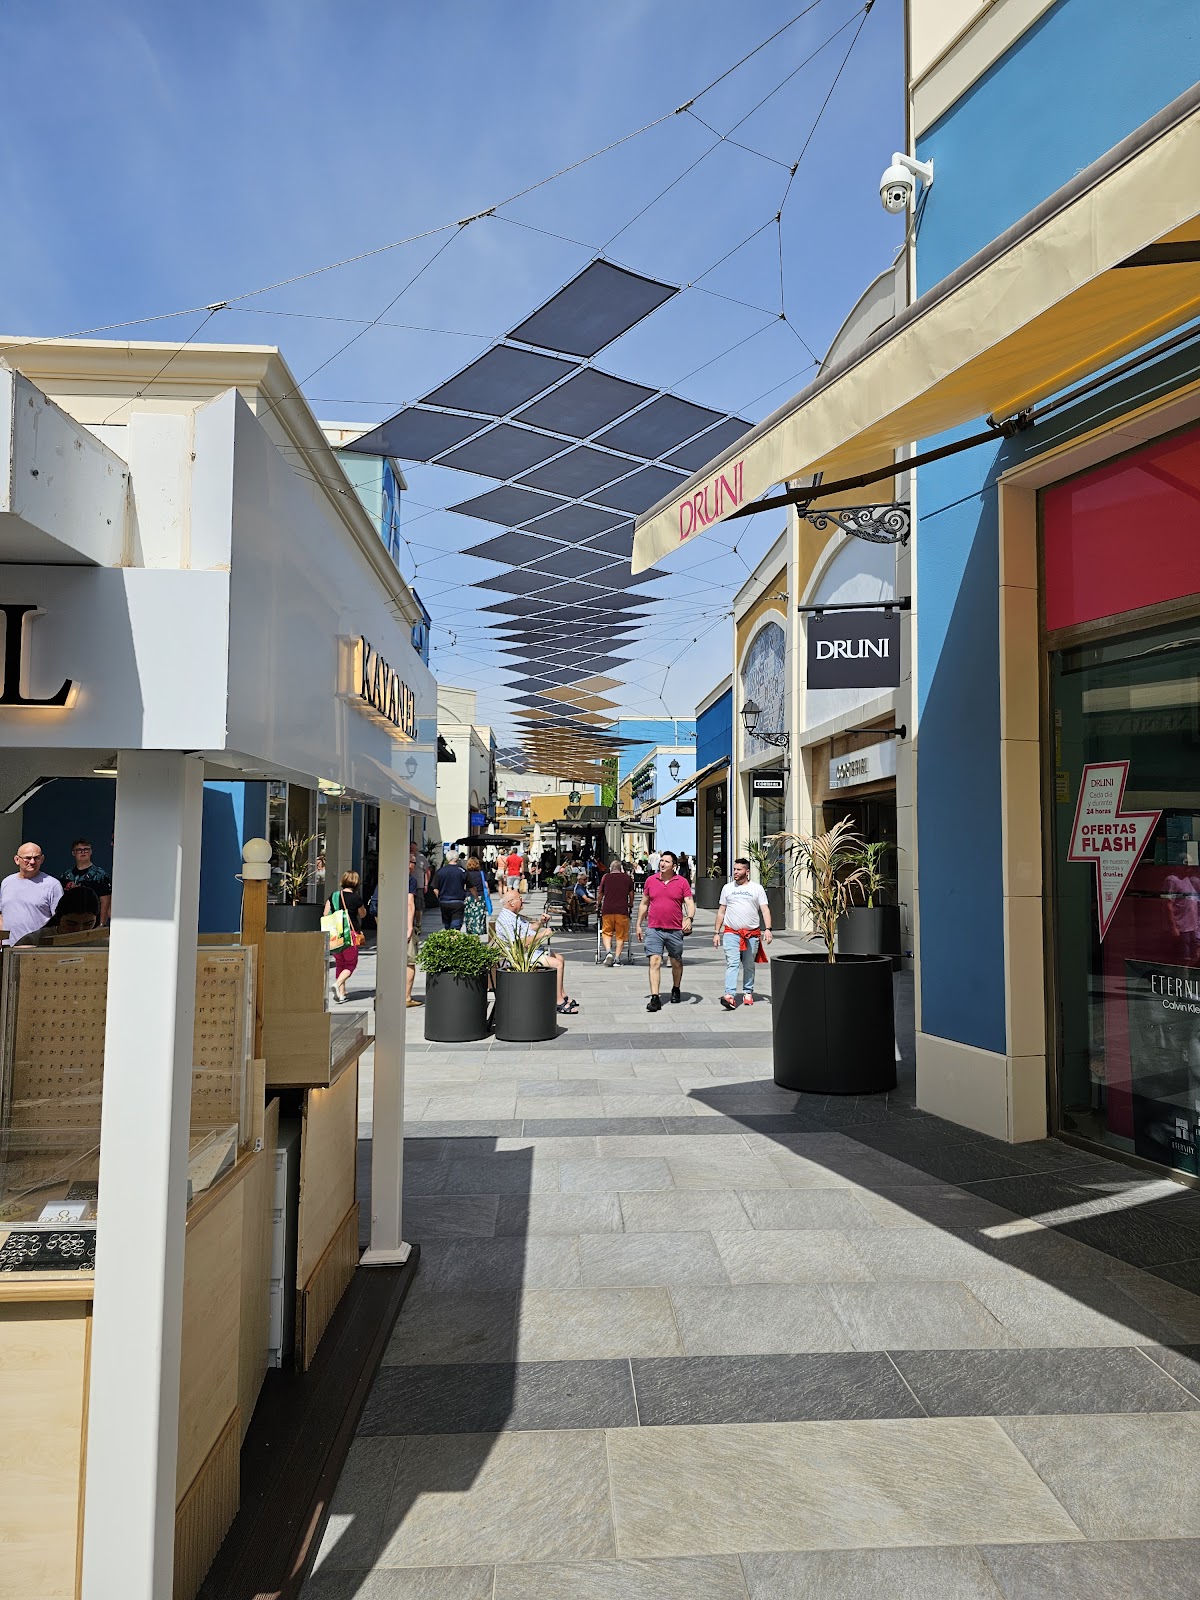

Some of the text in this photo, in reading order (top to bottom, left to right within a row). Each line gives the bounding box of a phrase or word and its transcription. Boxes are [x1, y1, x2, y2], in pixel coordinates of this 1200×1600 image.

[678, 460, 745, 542] DRUNI
[815, 638, 890, 661] DRUNI
[1091, 778, 1114, 788] DRUNI
[1081, 823, 1137, 836] OFERTAS
[1081, 837, 1136, 852] FLASH
[1162, 999, 1188, 1012] Calvin
